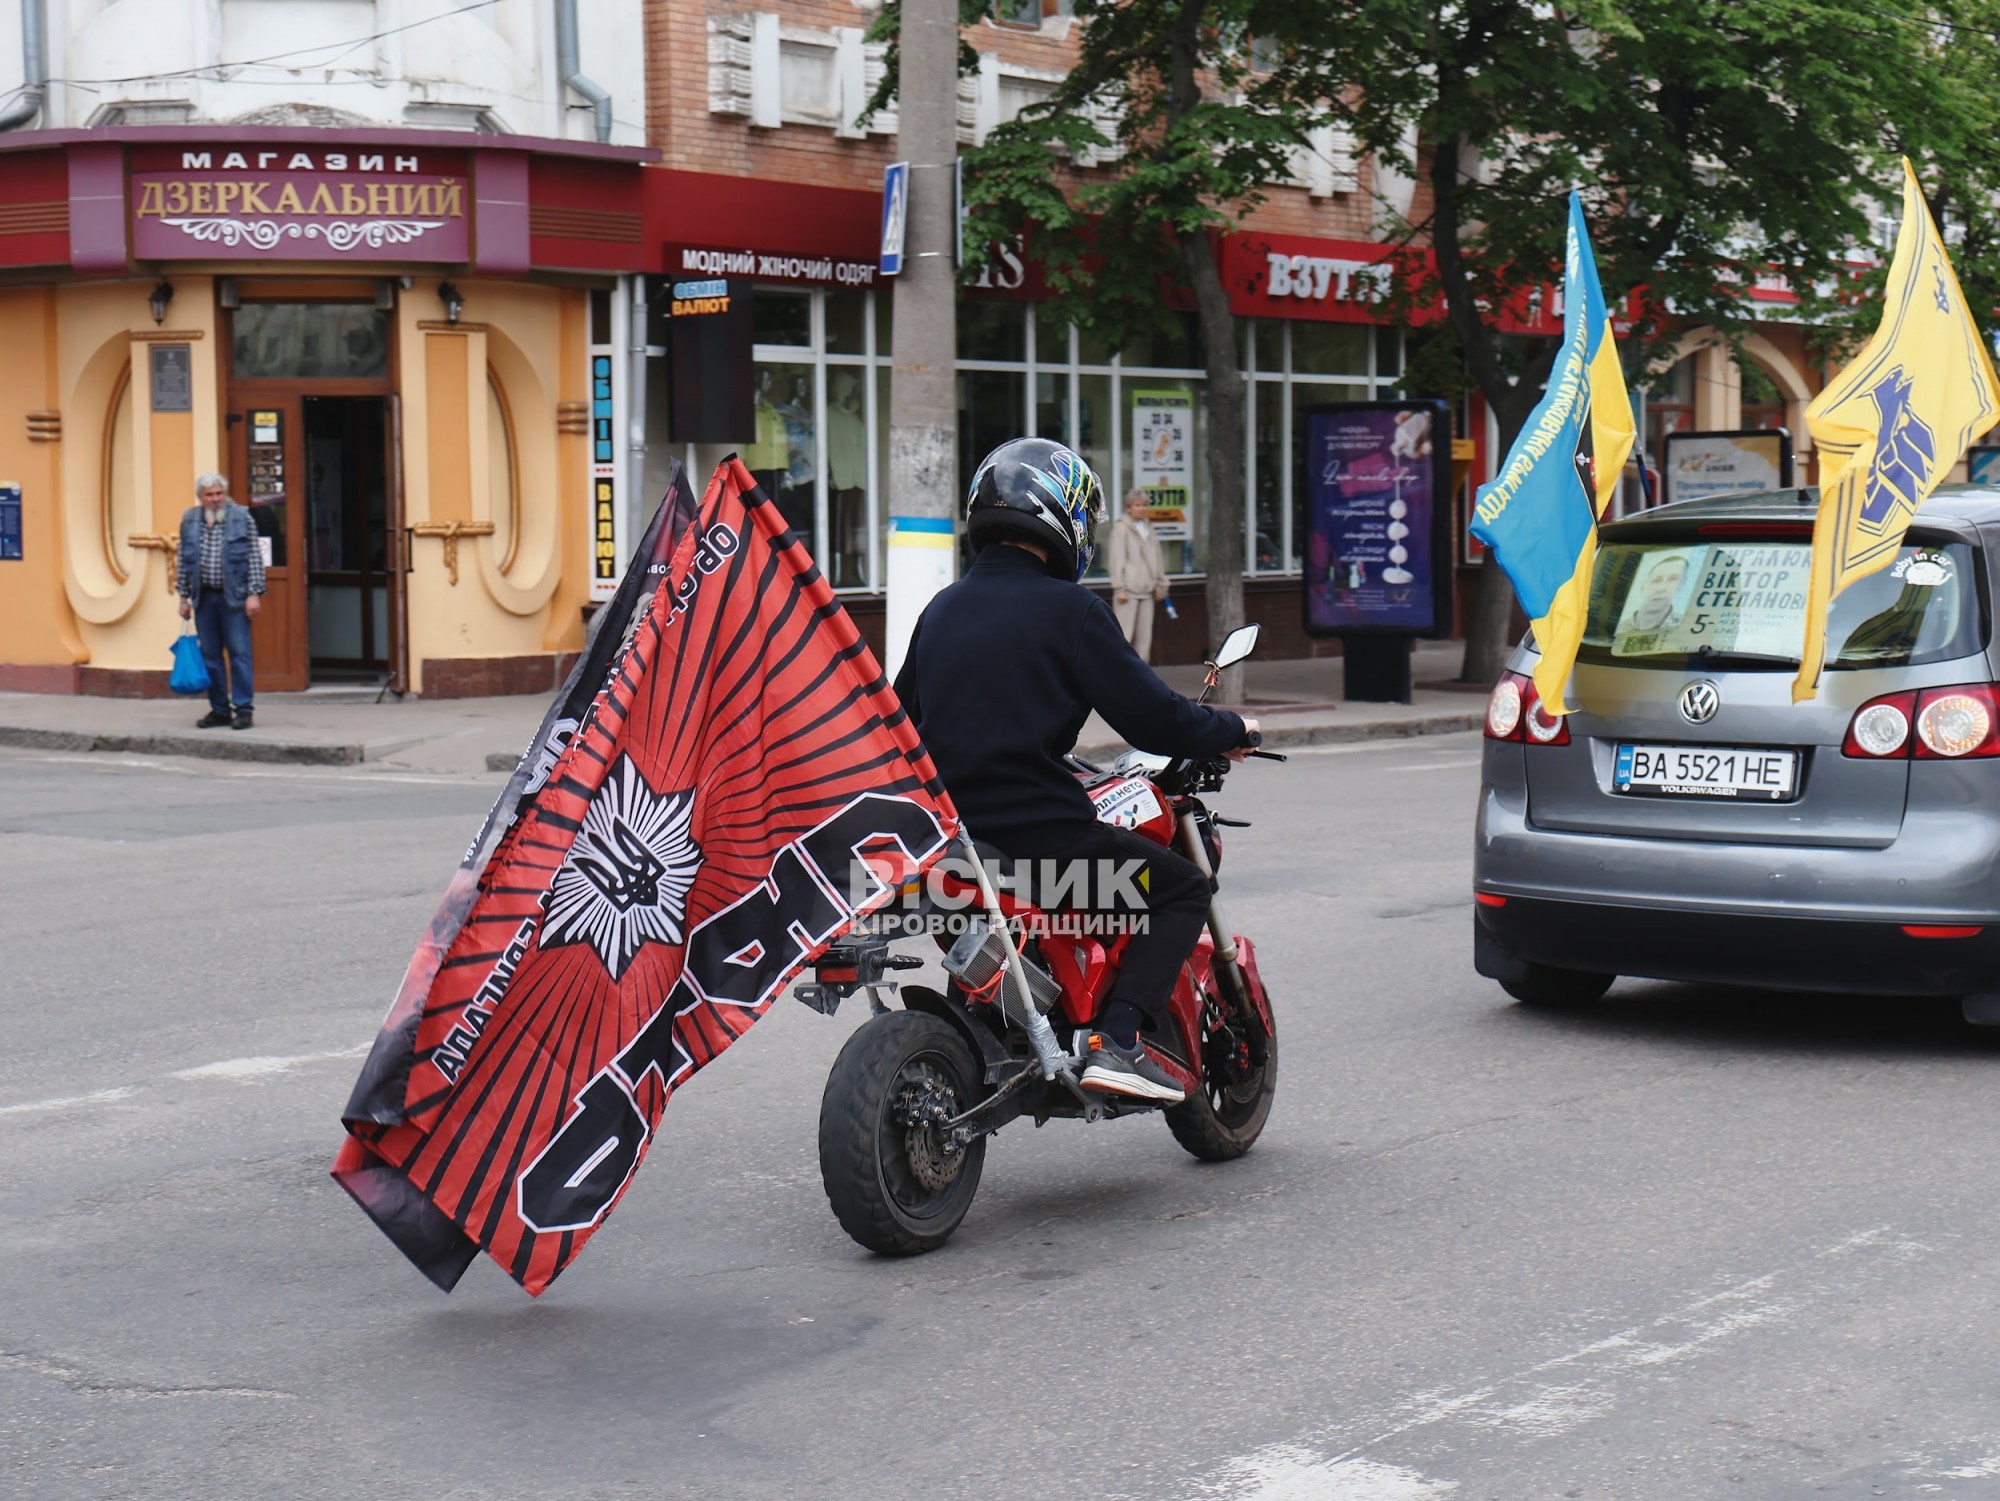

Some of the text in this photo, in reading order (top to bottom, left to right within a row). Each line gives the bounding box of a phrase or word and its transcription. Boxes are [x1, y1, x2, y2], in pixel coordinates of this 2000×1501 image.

[182, 152, 418, 172] МАГАЗИН
[137, 178, 463, 219] ДЗЕРКАЛЬНИЙ
[683, 250, 877, 285] МОДНИЙ ЖІНОЧИЙ ОДЯГ
[673, 279, 728, 299] ОБМІН
[671, 297, 732, 316] ВАЛЮТ
[594, 358, 613, 460] ОБМІН
[1146, 489, 1186, 506] ЗУТТЯ
[596, 484, 615, 577] ВАЛЮТ
[1890, 552, 1952, 578] Baby in car
[1633, 752, 1782, 785] BA 5521 HE
[1661, 784, 1738, 797] VOLKSWAGEN
